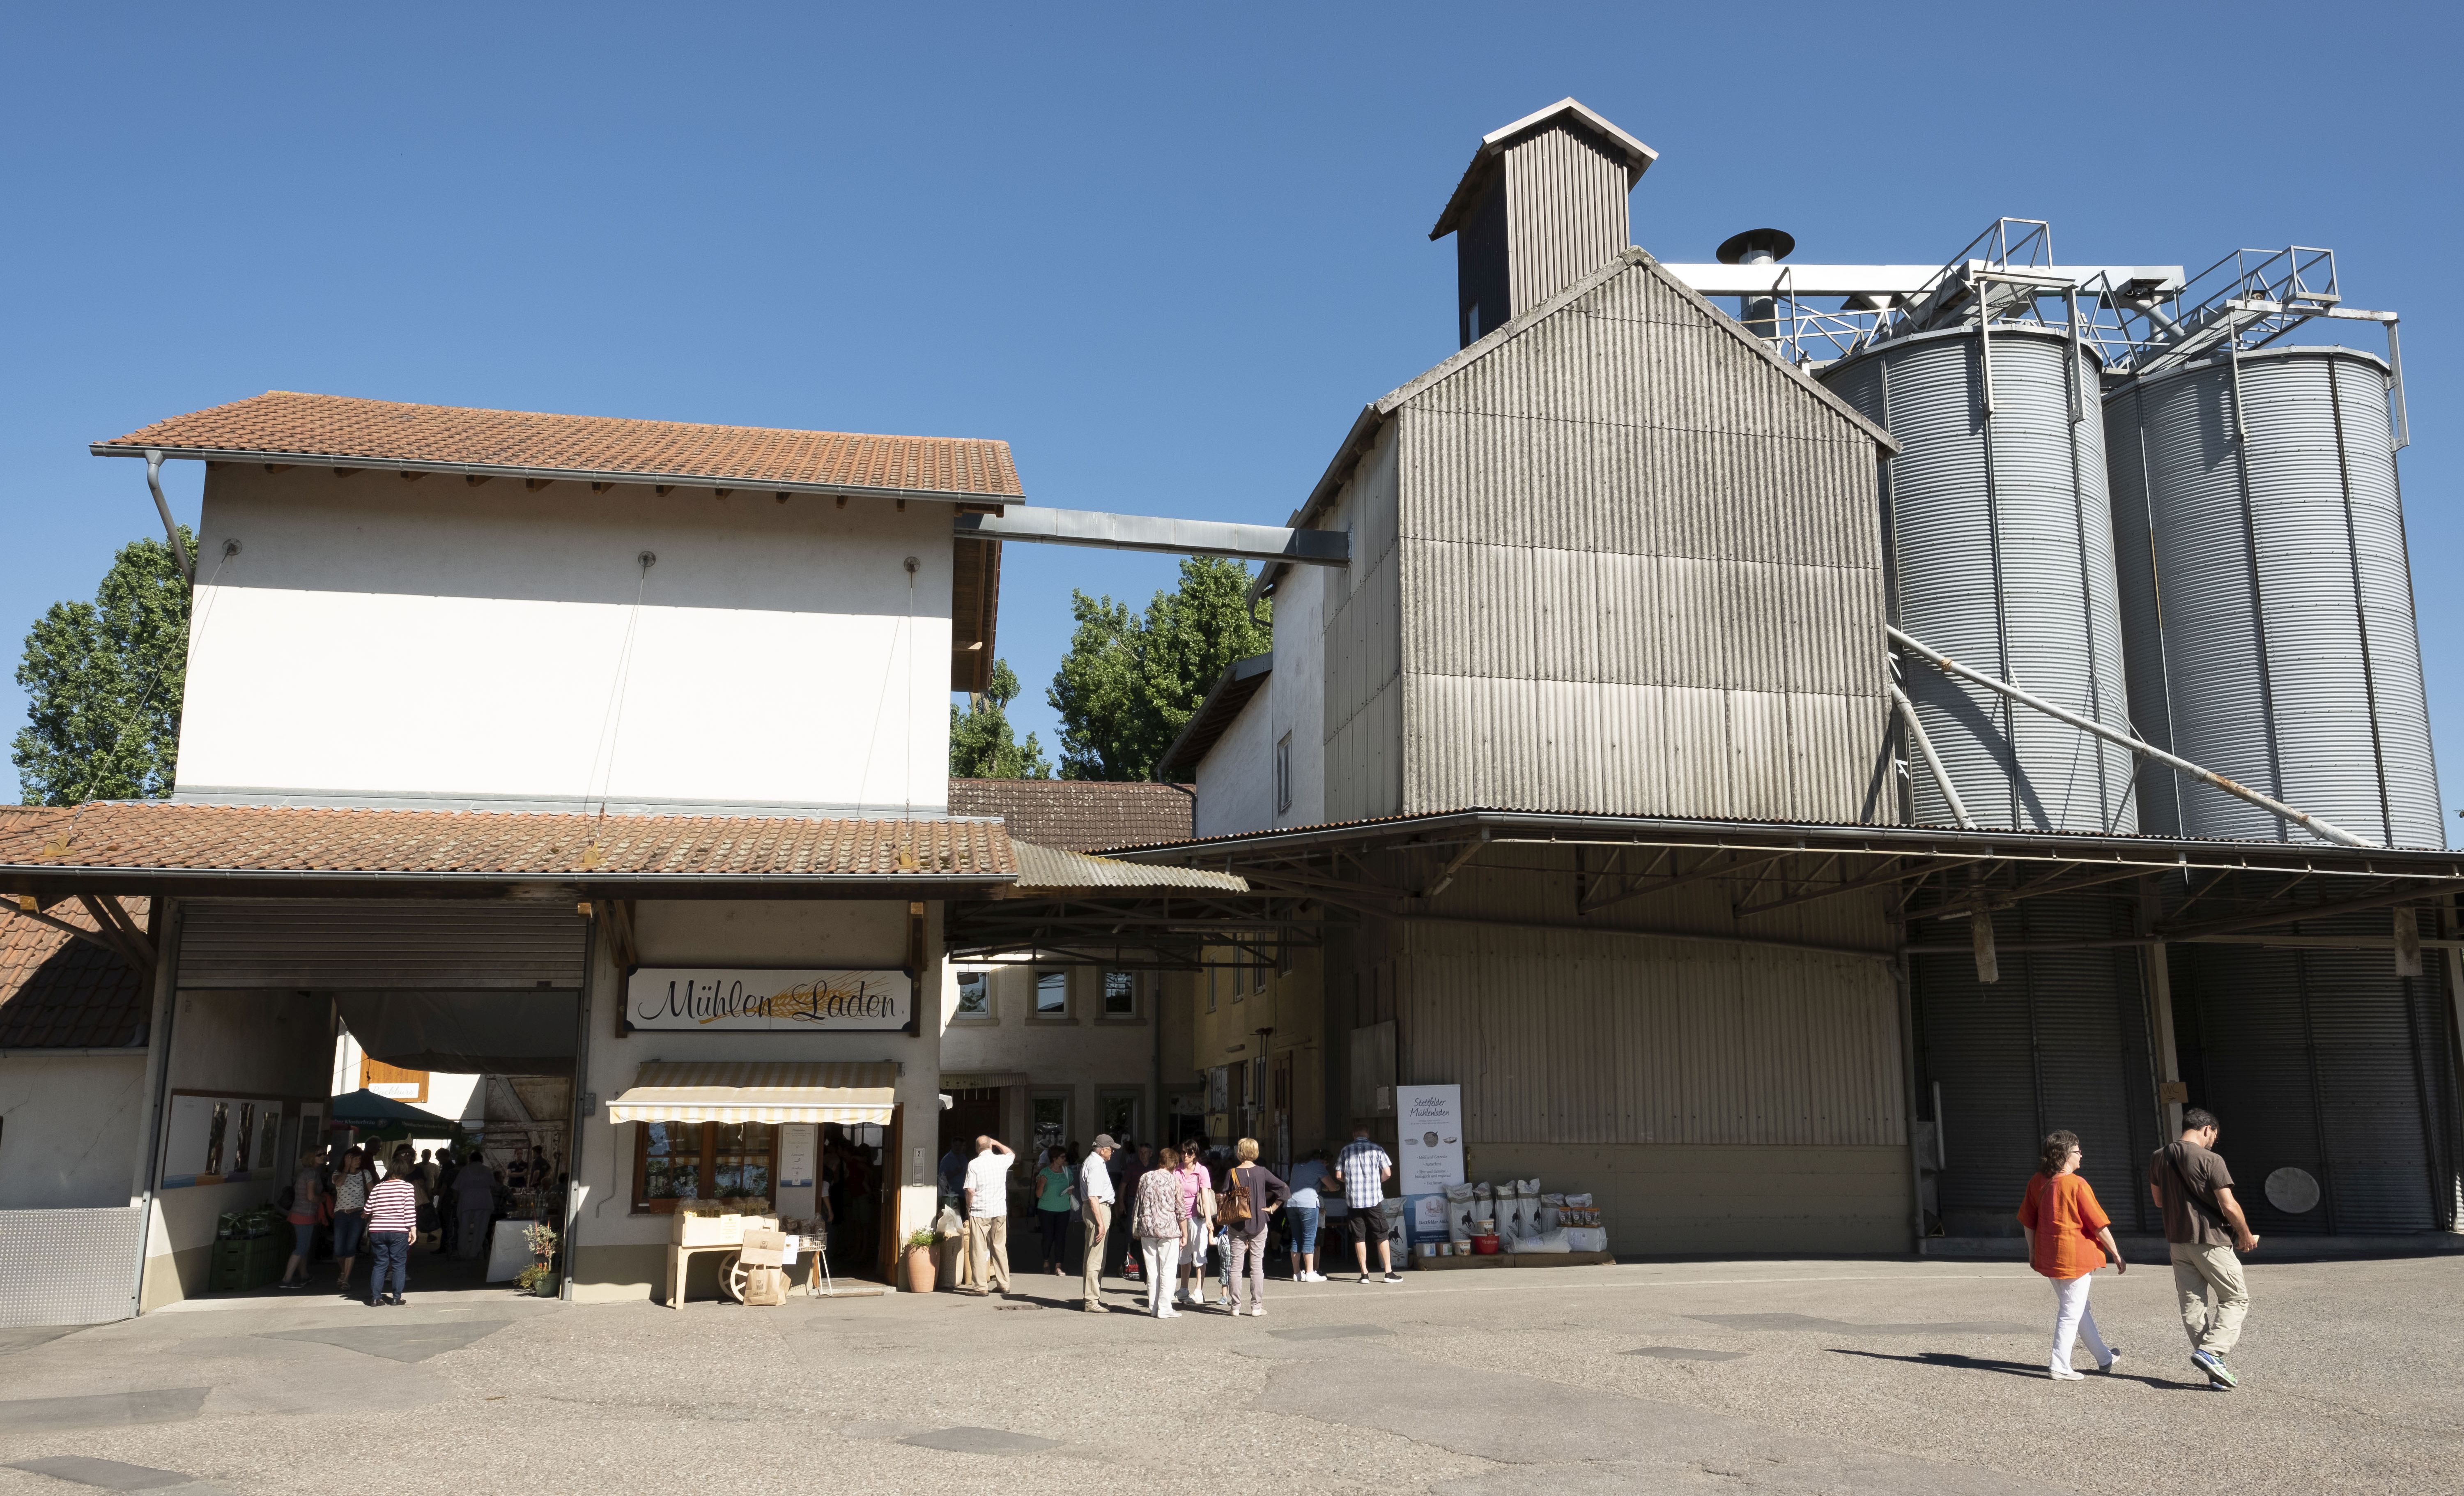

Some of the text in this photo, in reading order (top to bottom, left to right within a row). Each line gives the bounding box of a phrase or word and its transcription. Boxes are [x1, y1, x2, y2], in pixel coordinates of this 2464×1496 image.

[638, 980, 896, 1022] Mühlen Laden
[372, 1086, 413, 1095] Backkurs
[2161, 1082, 2179, 1094] WC
[1414, 1097, 1446, 1107] Stettfelder
[1410, 1107, 1449, 1117] Mühlenladen
